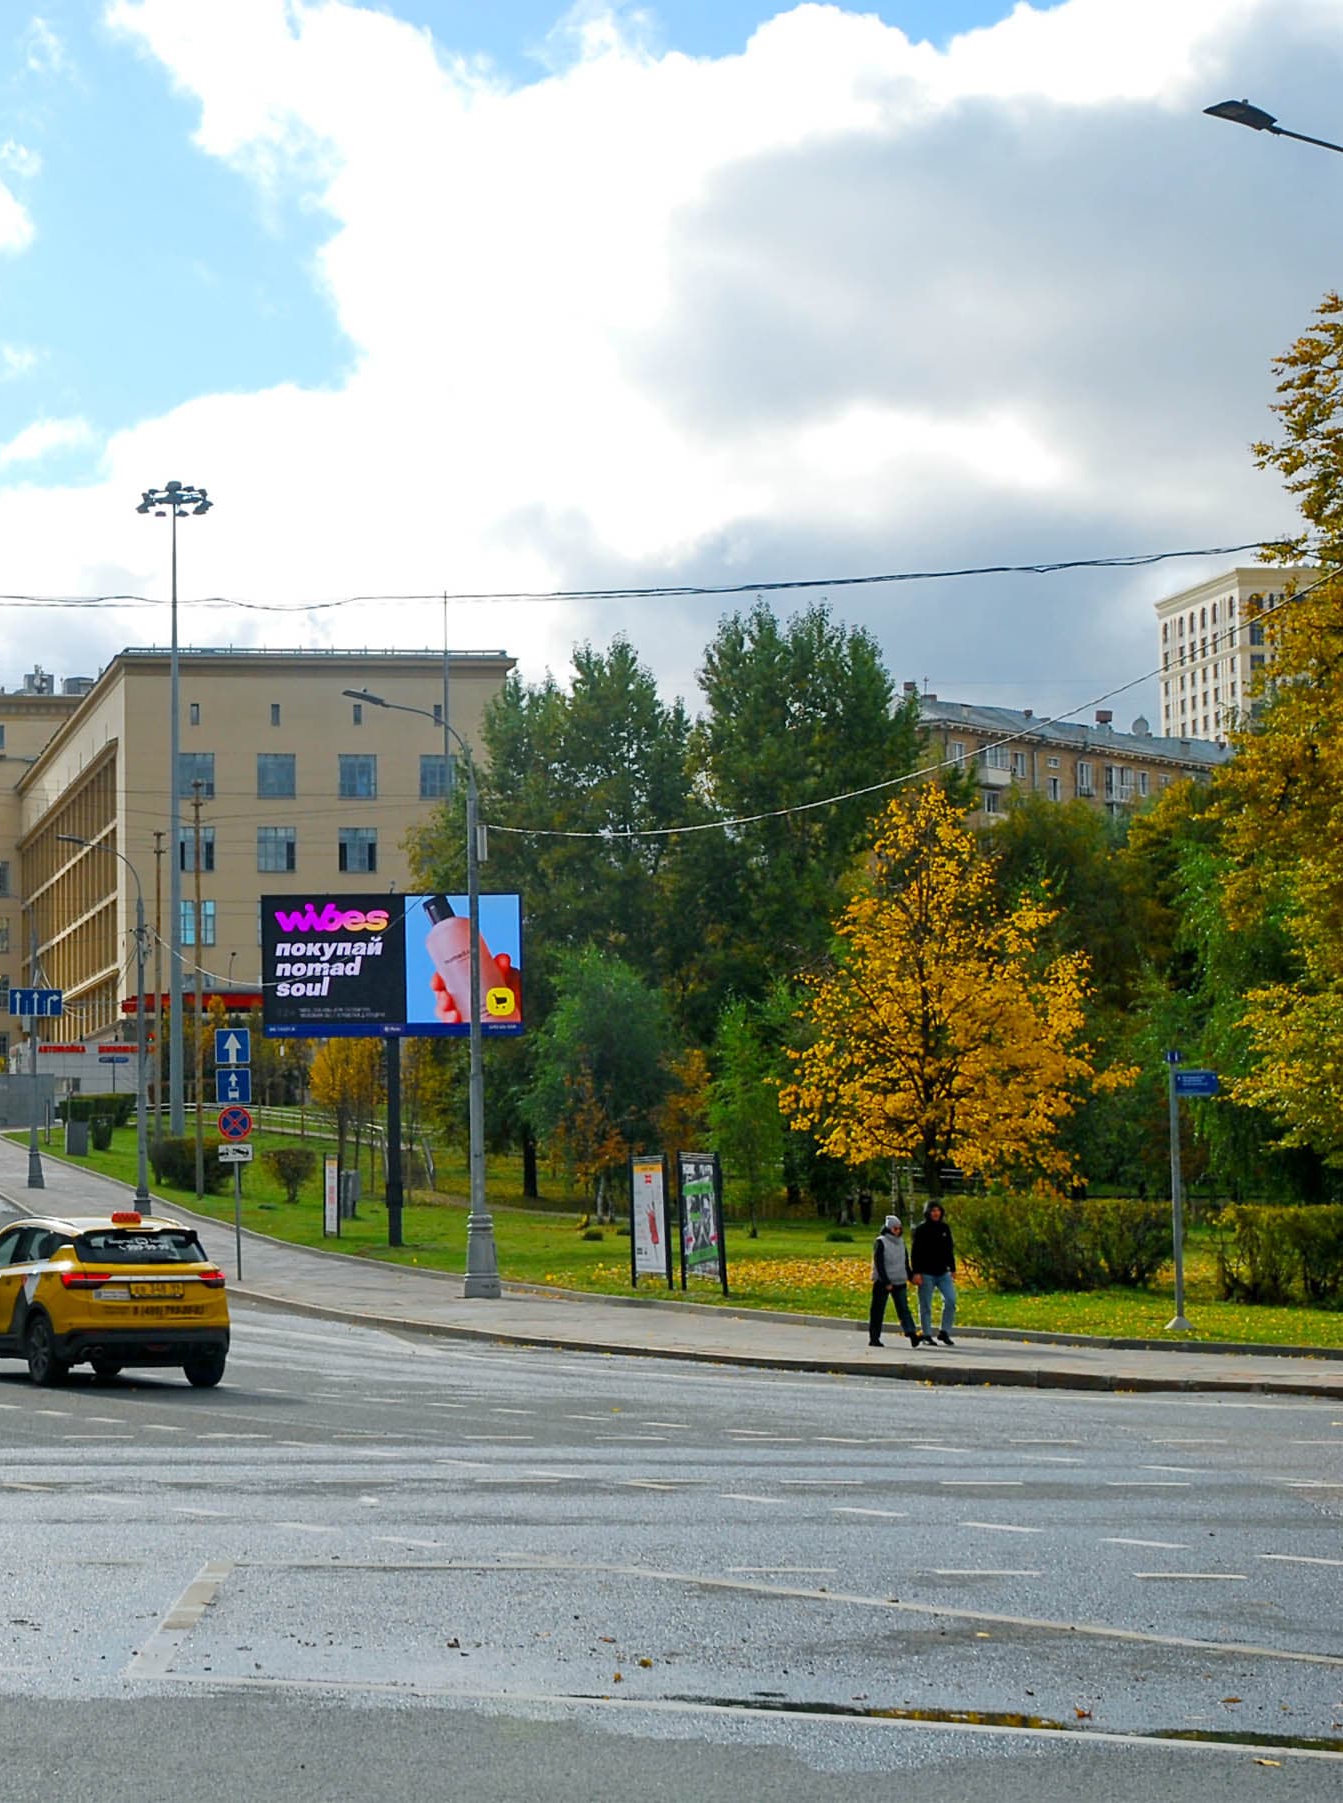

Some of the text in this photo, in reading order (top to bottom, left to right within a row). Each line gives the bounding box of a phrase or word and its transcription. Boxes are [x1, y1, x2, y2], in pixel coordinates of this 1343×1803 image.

[274, 903, 389, 932] wibes
[275, 936, 383, 961] покупай
[275, 956, 362, 977] nomad
[276, 976, 330, 997] soul
